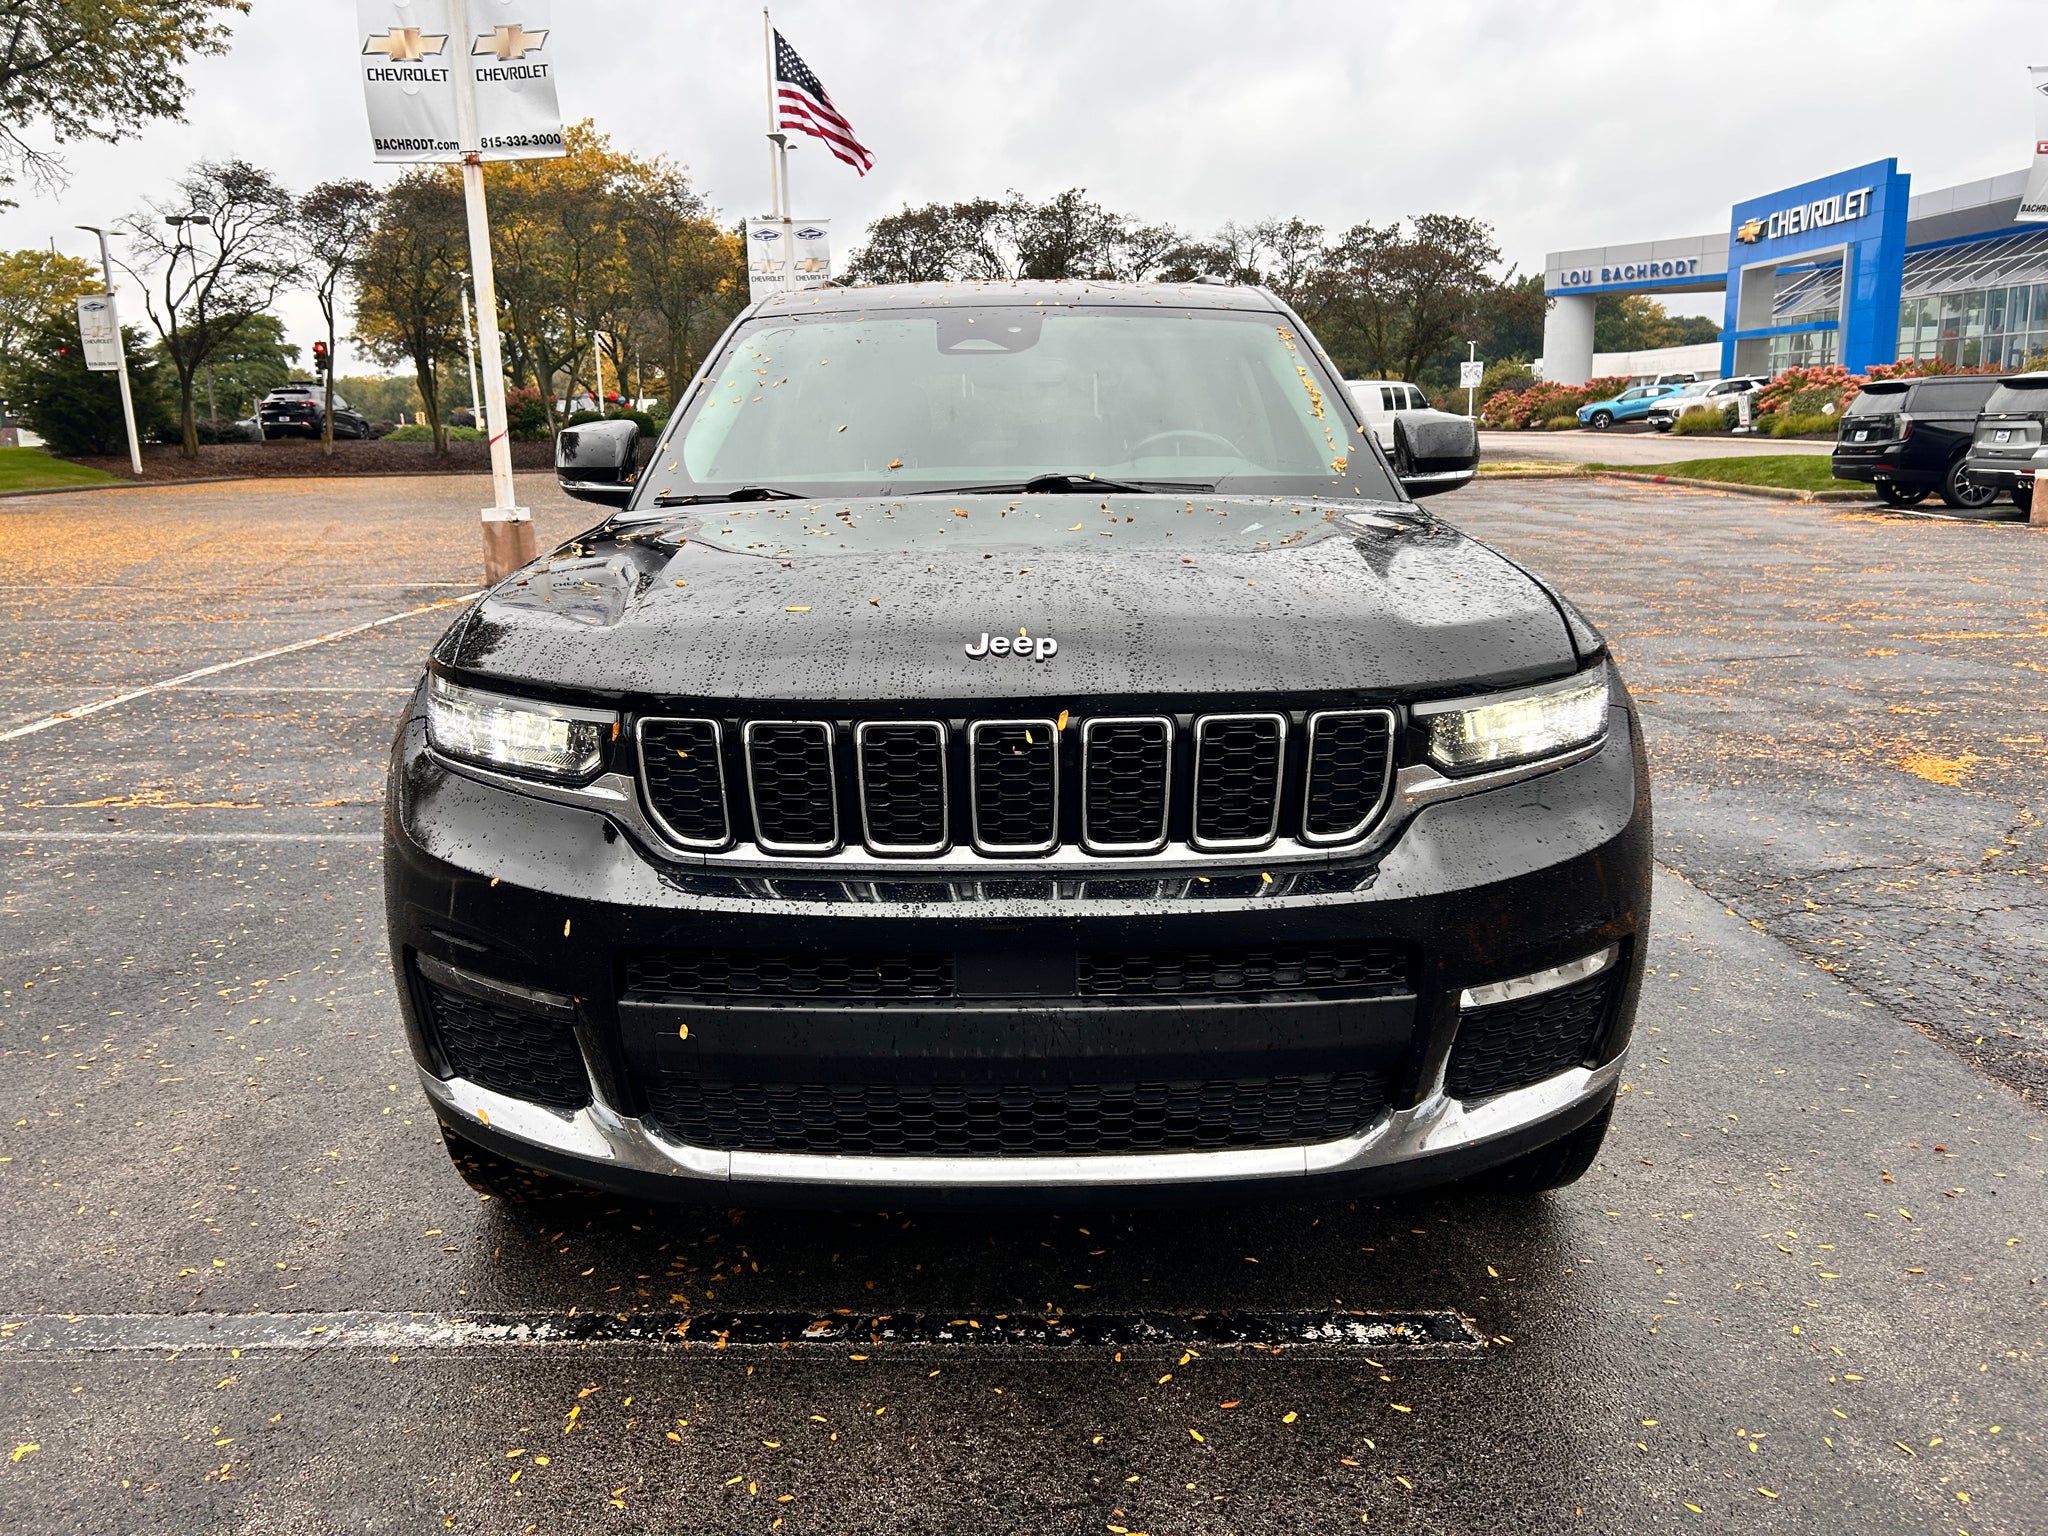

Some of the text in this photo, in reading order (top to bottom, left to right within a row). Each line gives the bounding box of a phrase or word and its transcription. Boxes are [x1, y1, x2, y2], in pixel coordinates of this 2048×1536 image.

[366, 68, 449, 82] CHEVROLET
[475, 64, 549, 82] CHEVROLET
[374, 138, 460, 151] BACHRODT.com
[480, 133, 561, 149] 815-332-3000
[1767, 186, 1873, 239] CHEVROLET
[2020, 203, 2048, 213] BACHR
[1560, 259, 1697, 287] LOU BACHRODT
[964, 632, 1059, 663] Jeep
